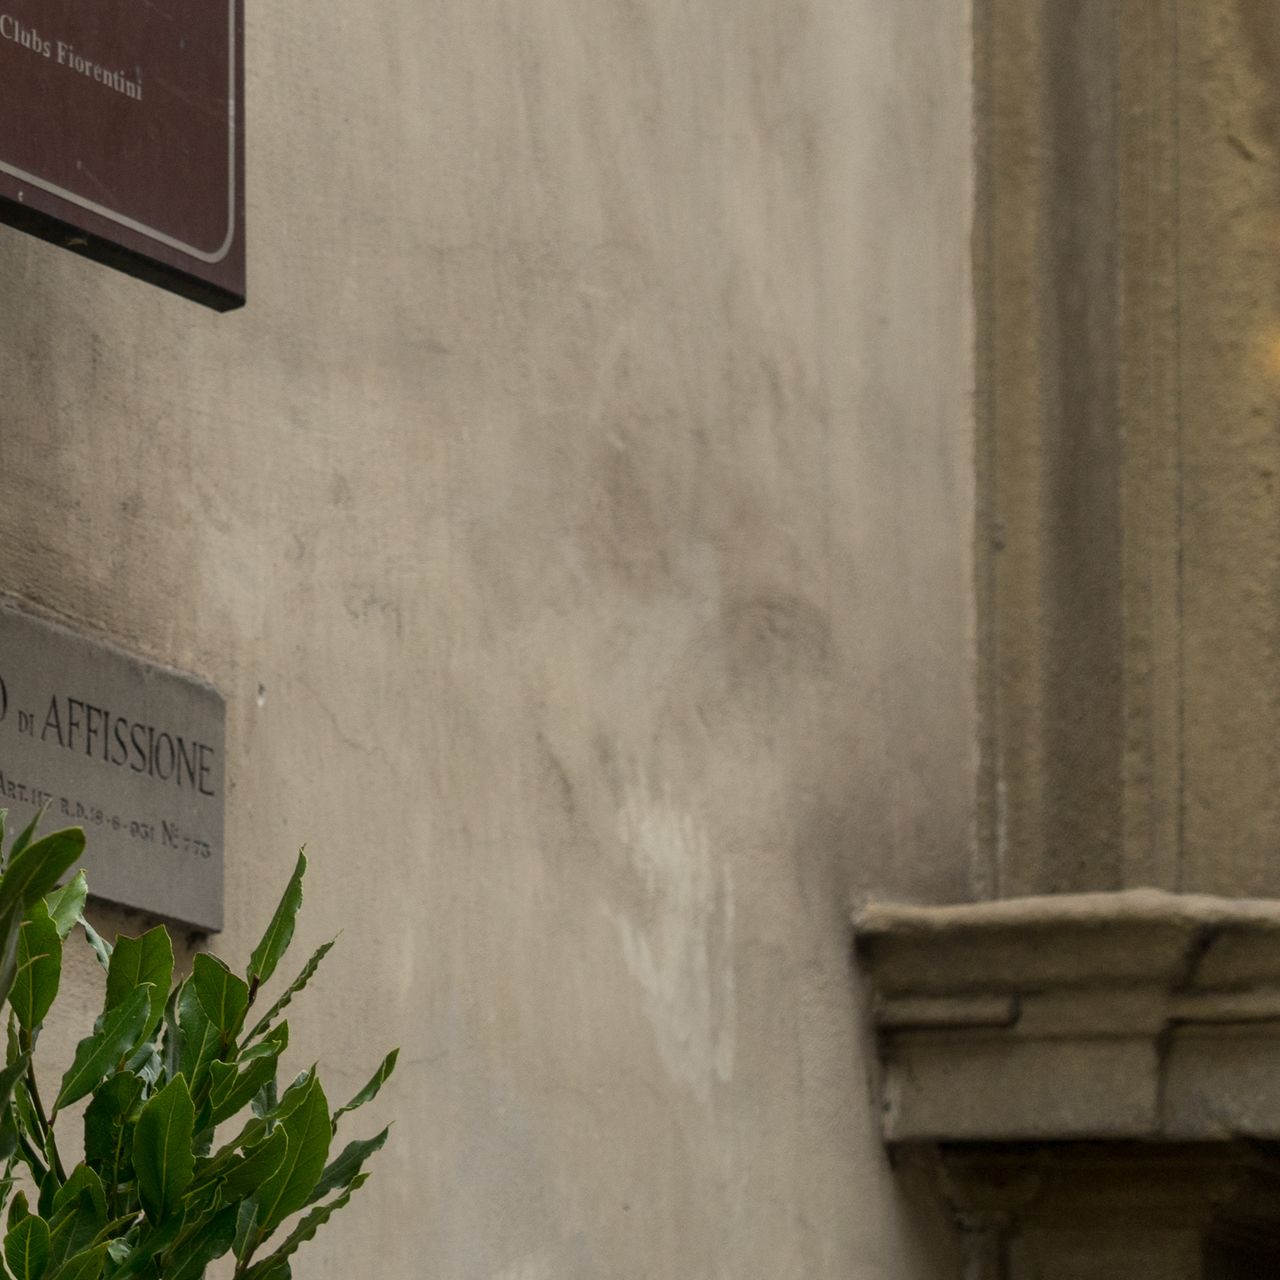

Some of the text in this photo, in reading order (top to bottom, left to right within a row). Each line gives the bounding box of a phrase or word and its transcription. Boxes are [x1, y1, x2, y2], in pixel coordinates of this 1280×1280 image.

[0, 15, 50, 57] Clubs
[58, 40, 141, 99] Fiorentini
[18, 710, 35, 737] DI
[41, 694, 216, 797] AFFISSIONE
